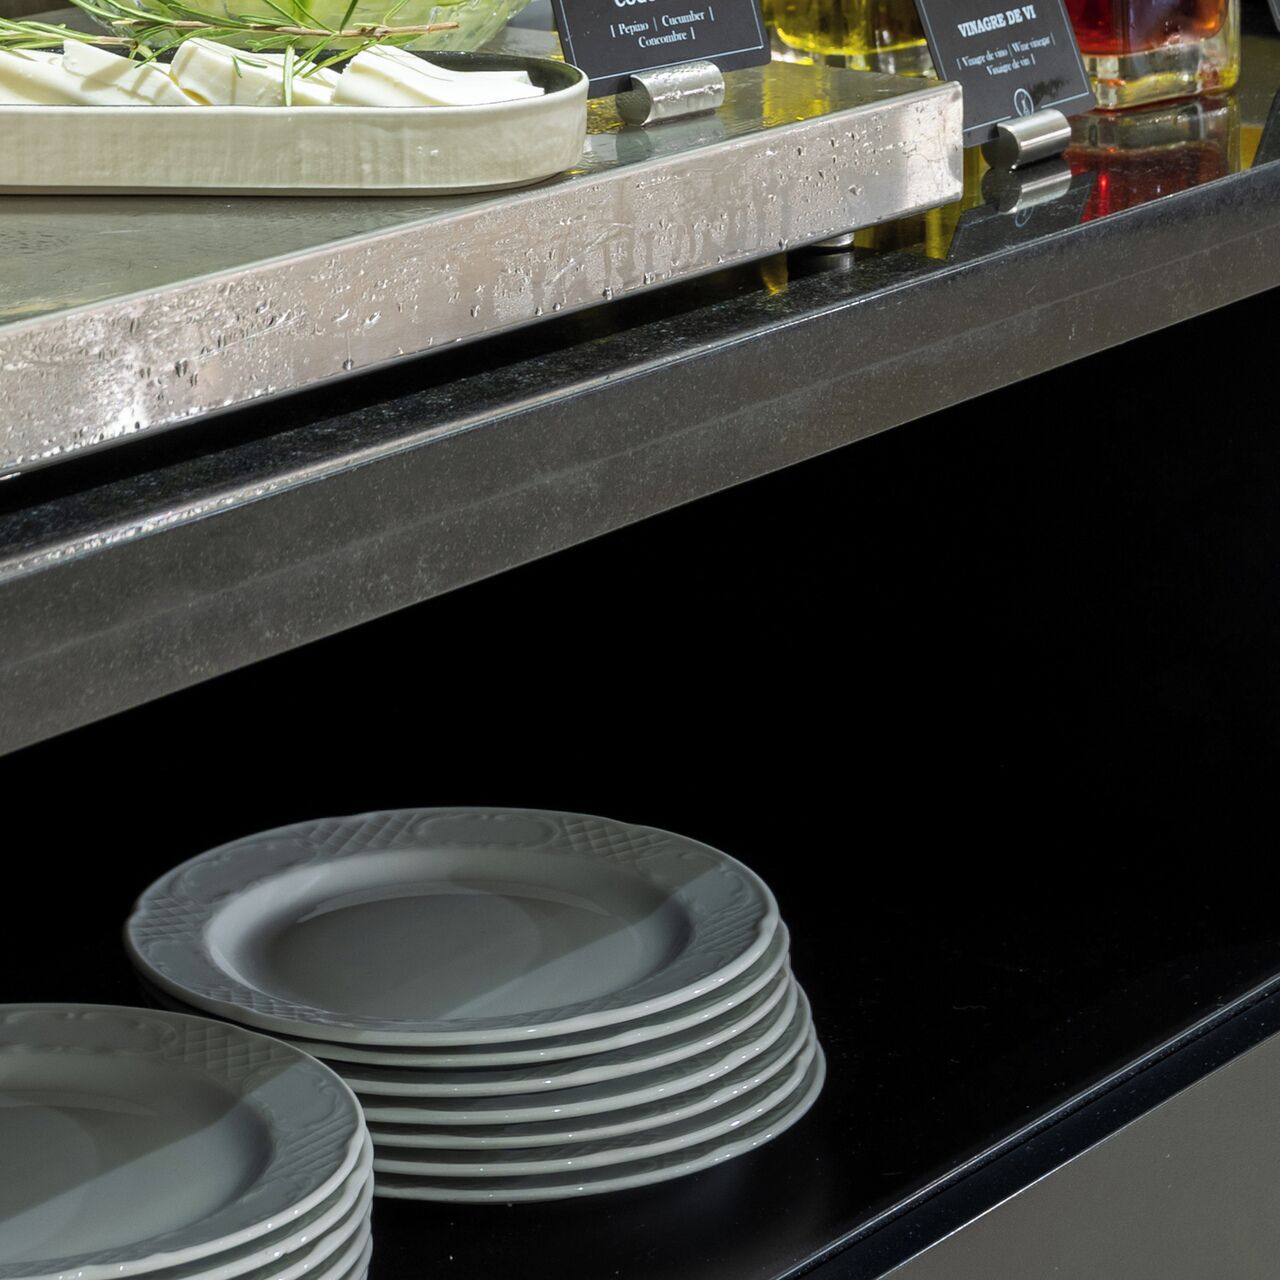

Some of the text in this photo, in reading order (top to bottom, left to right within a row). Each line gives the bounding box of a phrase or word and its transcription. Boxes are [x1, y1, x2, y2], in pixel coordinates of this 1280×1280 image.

[618, 10, 705, 35] Pepino Cucumber
[958, 4, 1036, 38] VINAGRE DE VI
[638, 30, 687, 48] Concombre
[961, 36, 1050, 67] Vinagre de vino Wine vinegar
[1012, 58, 1020, 69] de
